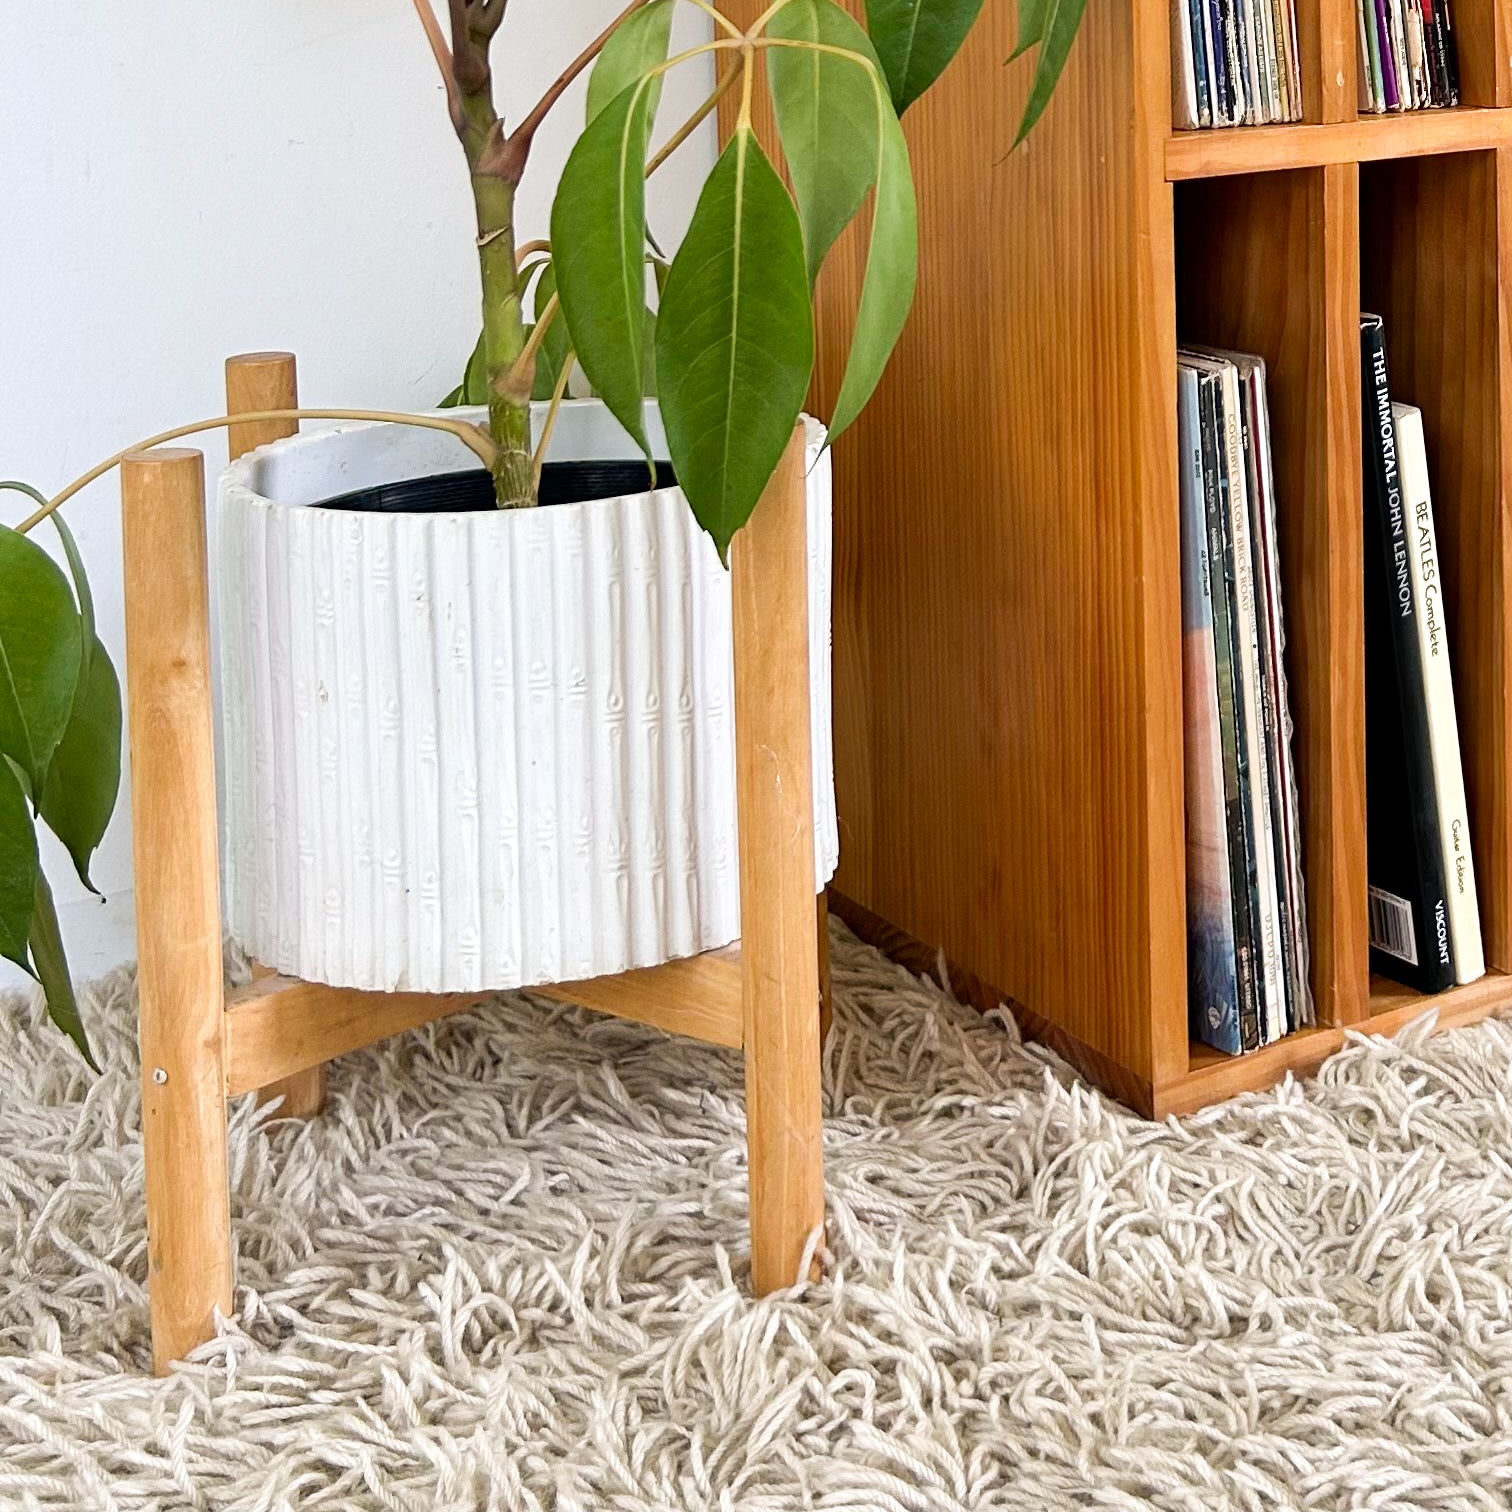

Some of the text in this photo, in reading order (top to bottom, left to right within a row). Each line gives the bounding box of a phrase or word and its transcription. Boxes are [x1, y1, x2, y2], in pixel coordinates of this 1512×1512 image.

[1227, 412, 1249, 612] GOODBYE YELLOW BRICK ROAD
[1372, 346, 1413, 617] THE IMMORTAL JOHN LENNON
[1414, 501, 1441, 658] BEATLES Complete
[1434, 899, 1450, 965] VISCOUNT
